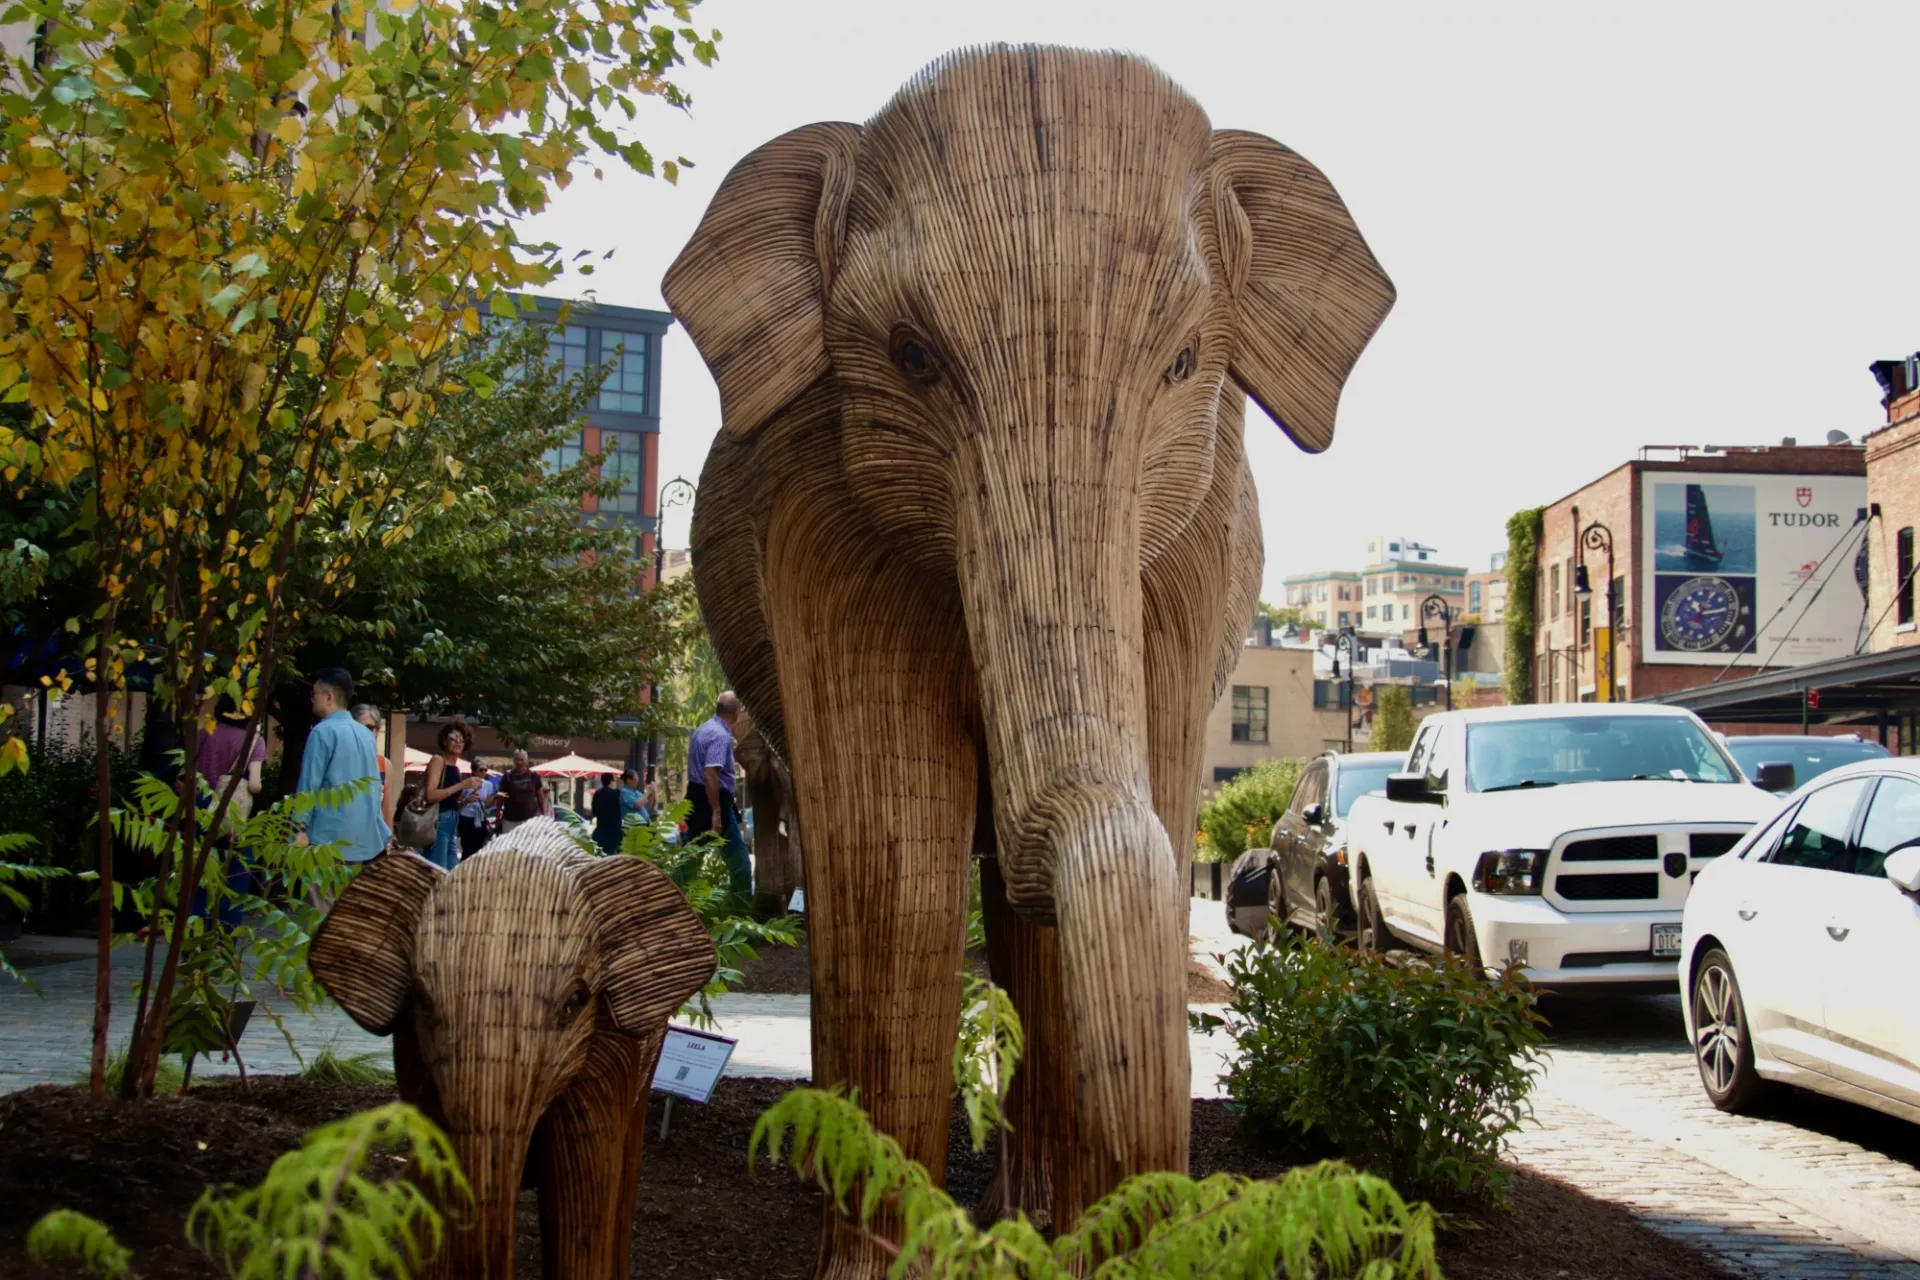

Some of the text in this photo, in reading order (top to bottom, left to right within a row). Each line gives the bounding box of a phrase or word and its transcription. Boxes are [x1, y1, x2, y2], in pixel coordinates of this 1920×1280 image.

[1769, 512, 1840, 528] TUDOR
[535, 736, 571, 748] Theory
[687, 1041, 706, 1051] LEELA
